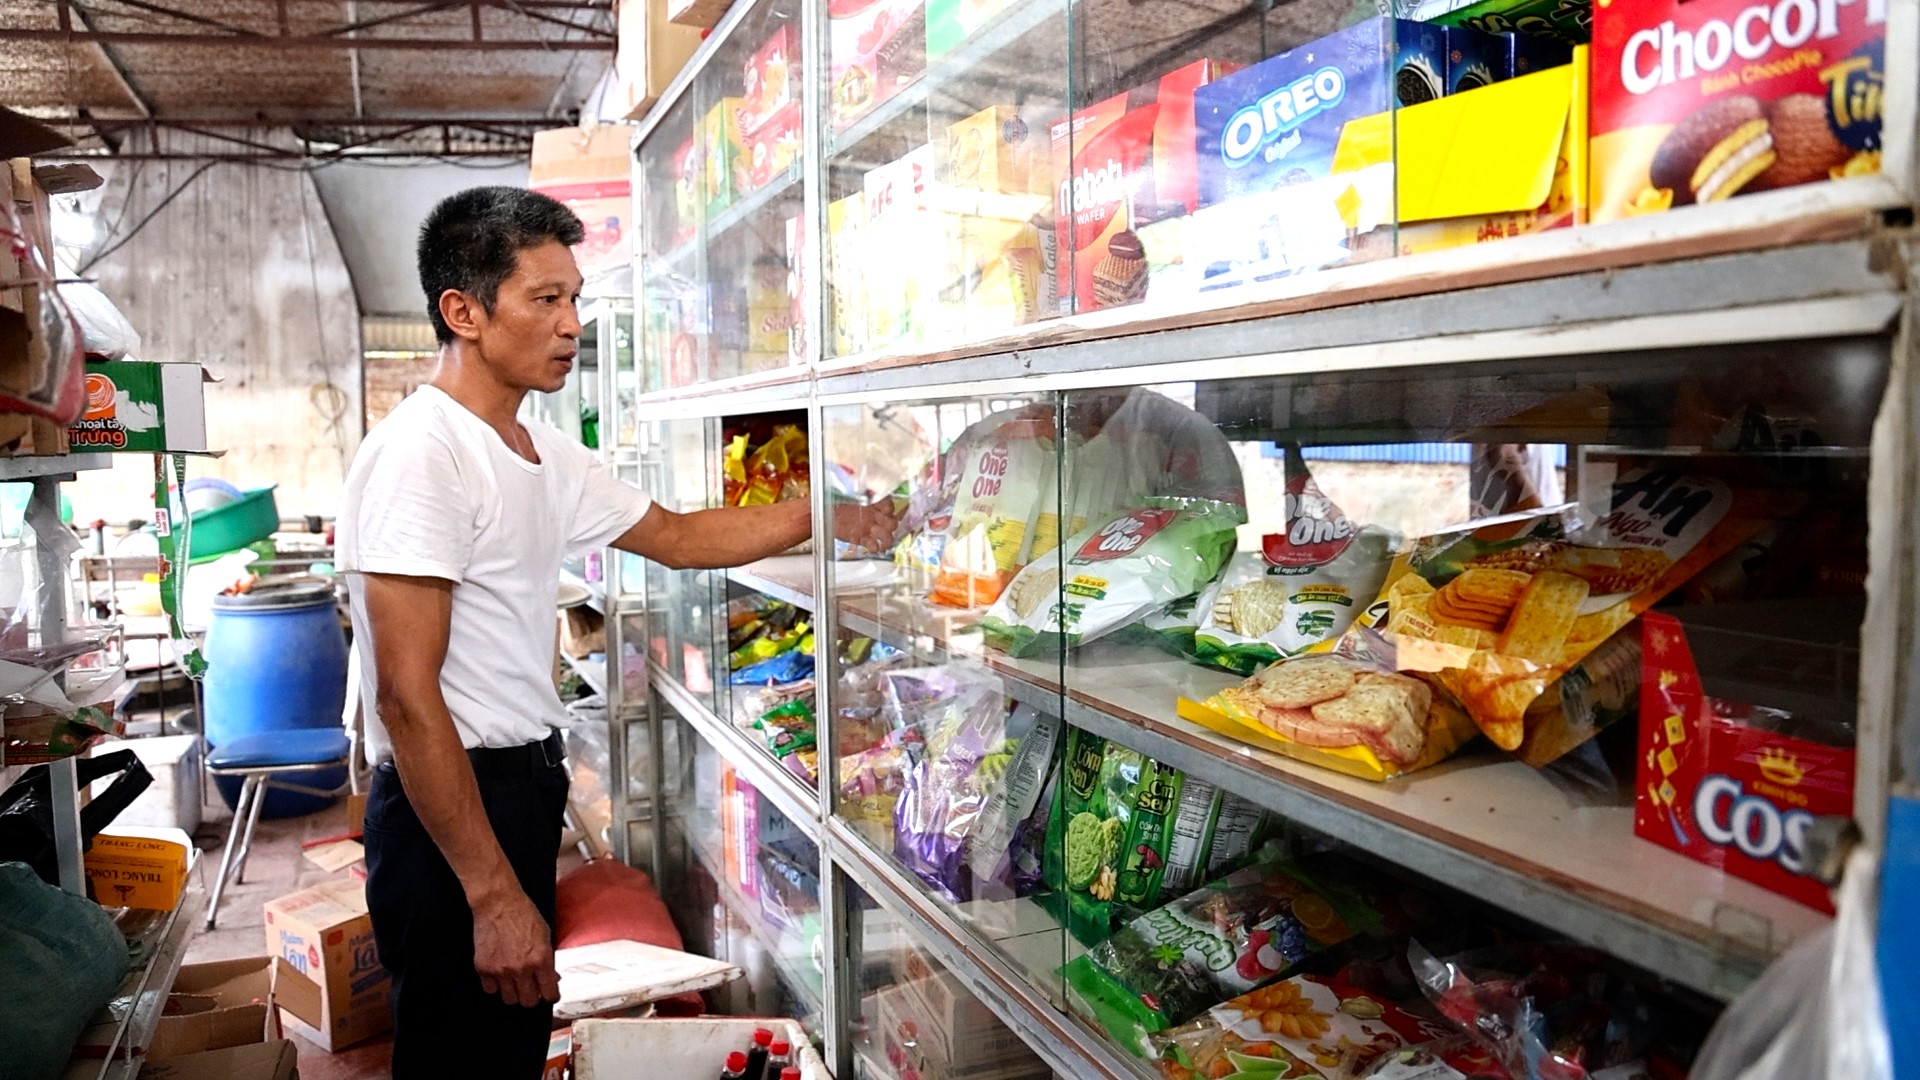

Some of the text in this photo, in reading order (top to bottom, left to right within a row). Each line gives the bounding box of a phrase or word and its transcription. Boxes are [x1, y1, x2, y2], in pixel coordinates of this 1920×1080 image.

[1225, 70, 1342, 159] OREO
[1076, 209, 1105, 226] WAFER
[979, 450, 1008, 477] One
[972, 475, 1001, 498] One
[1101, 516, 1145, 538] One
[1289, 514, 1350, 546] One
[1098, 530, 1143, 552] One
